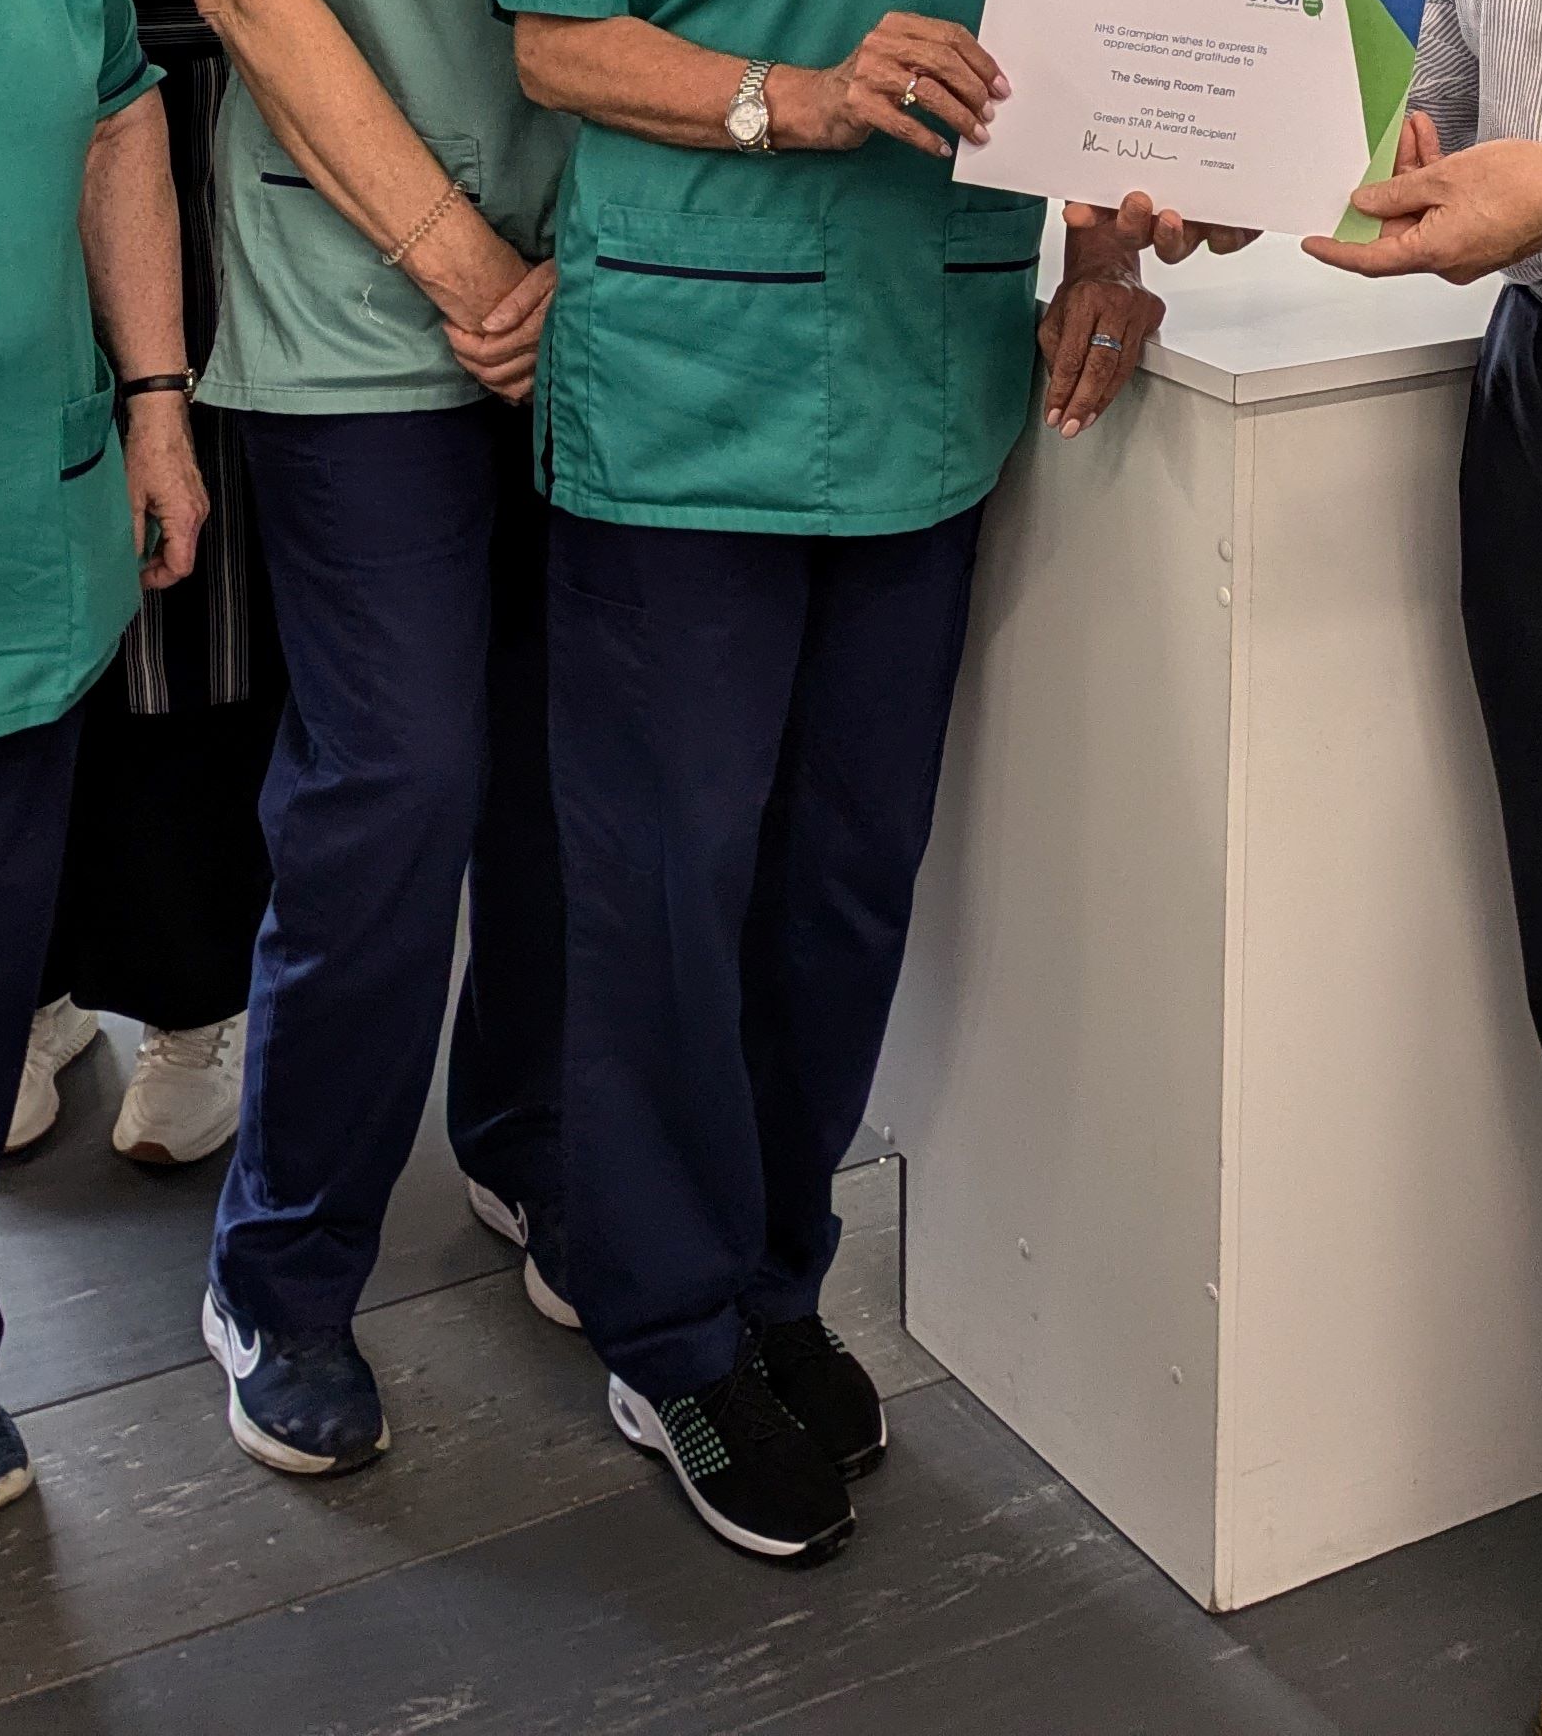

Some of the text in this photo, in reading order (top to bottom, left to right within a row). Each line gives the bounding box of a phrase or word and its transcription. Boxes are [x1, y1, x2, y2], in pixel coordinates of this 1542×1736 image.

[1094, 23, 1268, 55] NHS Grampian wishes to express its
[1103, 38, 1254, 67] appreciation and gratitude to
[1111, 69, 1236, 97] The Sewing Room Team
[1093, 111, 1237, 141] Green STAR Award Recipient
[1140, 107, 1196, 123] on being a
